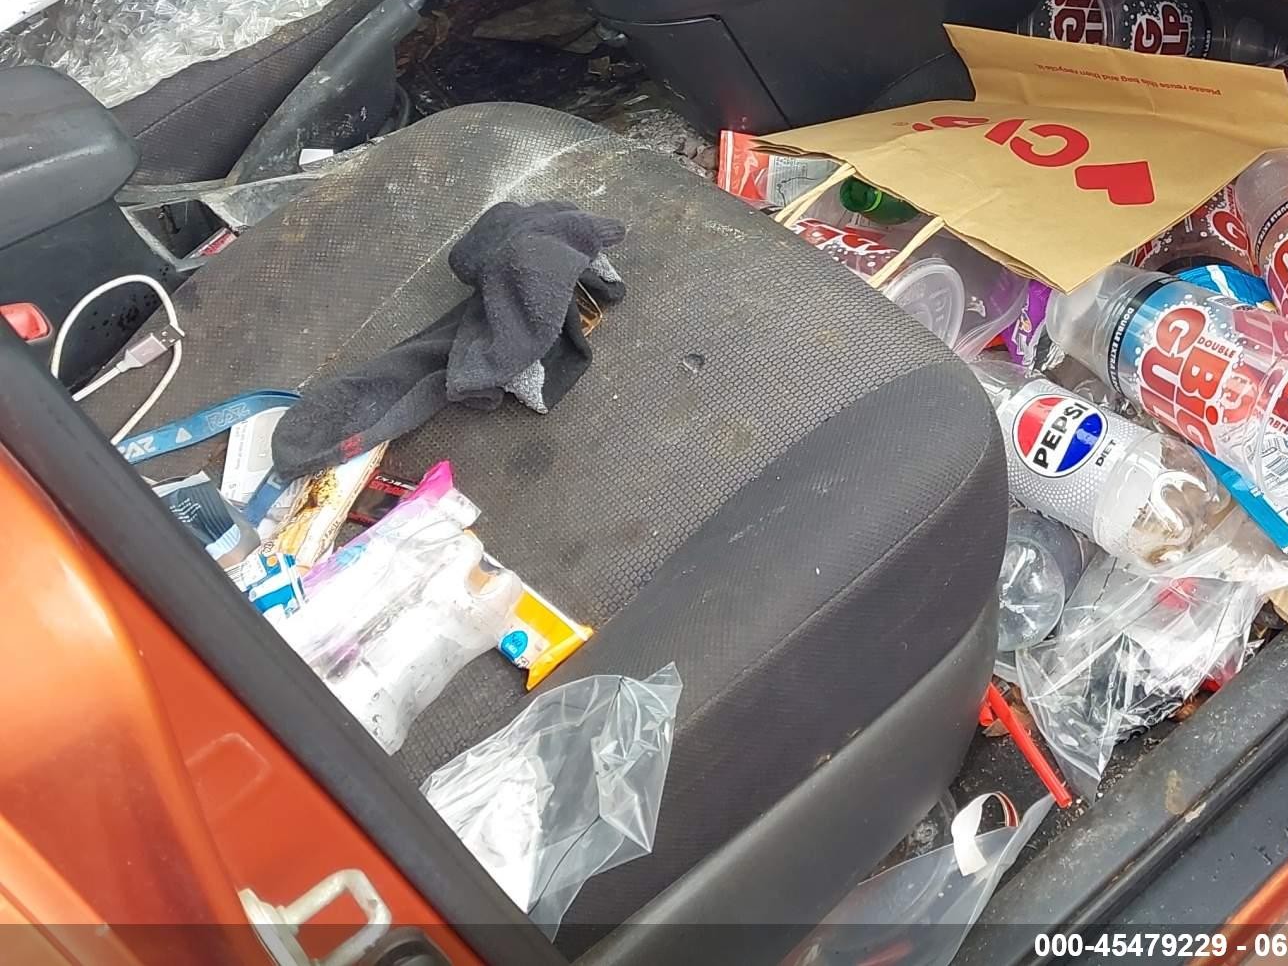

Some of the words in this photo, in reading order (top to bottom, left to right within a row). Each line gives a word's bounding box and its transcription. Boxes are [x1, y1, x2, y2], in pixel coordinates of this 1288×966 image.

[1189, 84, 1222, 96] Please
[1114, 307, 1135, 344] DOUBLE
[1109, 343, 1120, 368] EXTRA
[1196, 335, 1238, 360] DOUBLE
[1032, 402, 1090, 470] PEPSI
[1095, 439, 1117, 467] DIET
